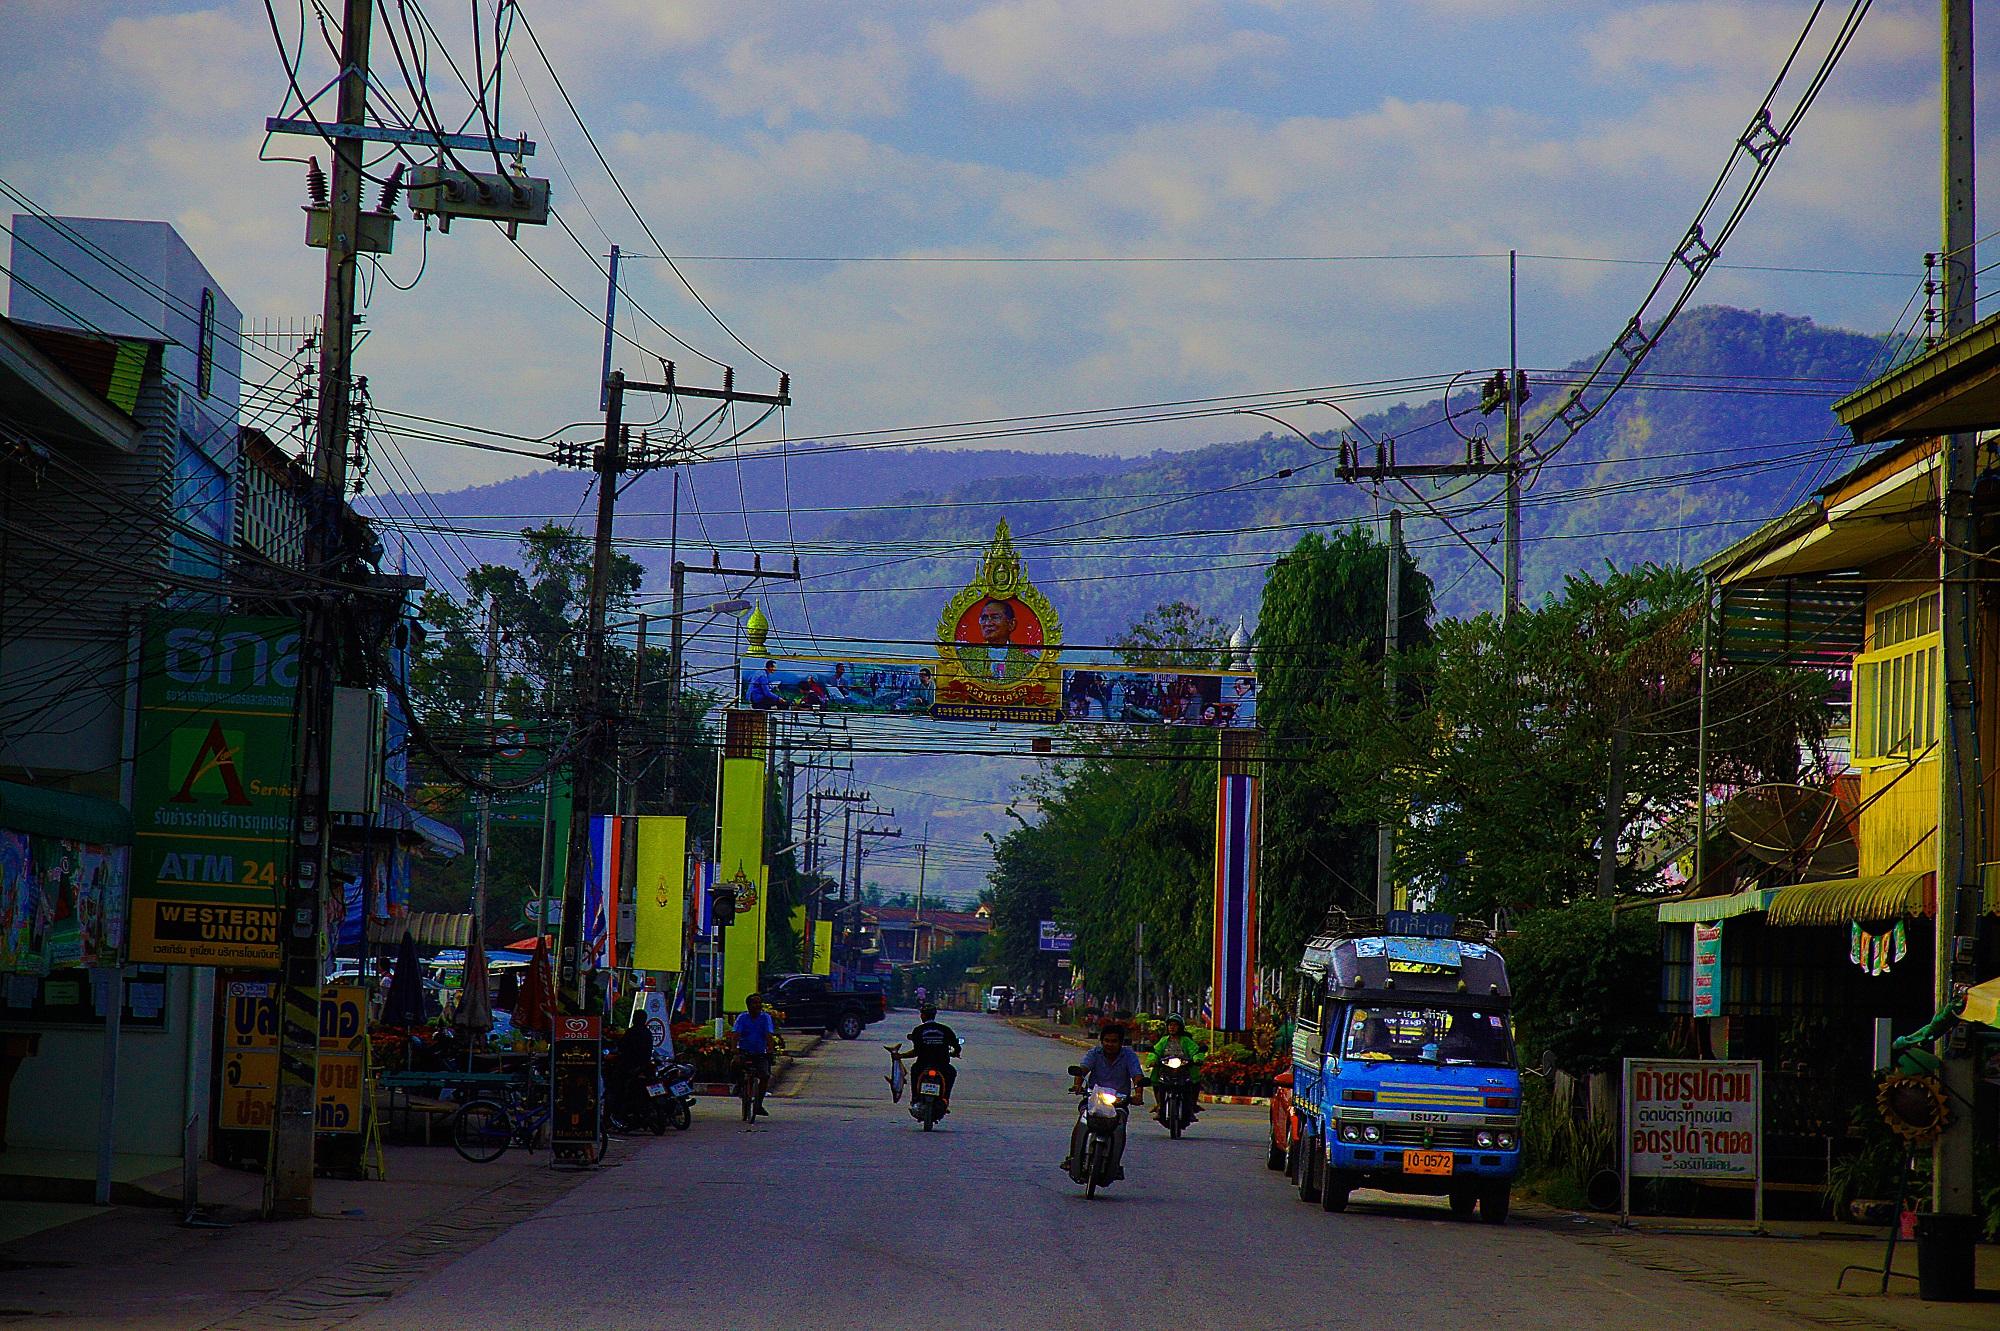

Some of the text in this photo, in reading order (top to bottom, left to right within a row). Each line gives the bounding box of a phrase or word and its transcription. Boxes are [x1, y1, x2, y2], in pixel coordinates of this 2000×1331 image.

[965, 684, 1029, 703] ทรงพระเจริญ
[158, 852, 276, 886] ATM 24
[161, 906, 277, 927] WESTERN
[201, 925, 277, 943] UNION
[1636, 1066, 1751, 1110] ถ่ายรูปด่วน
[1410, 1112, 1449, 1123] ISUZU
[1639, 1106, 1732, 1127] ติดบัตรทุกชนิด
[1632, 1124, 1753, 1162] อัดรูปดิจิตอล
[1408, 1152, 1451, 1168] 10-0572
